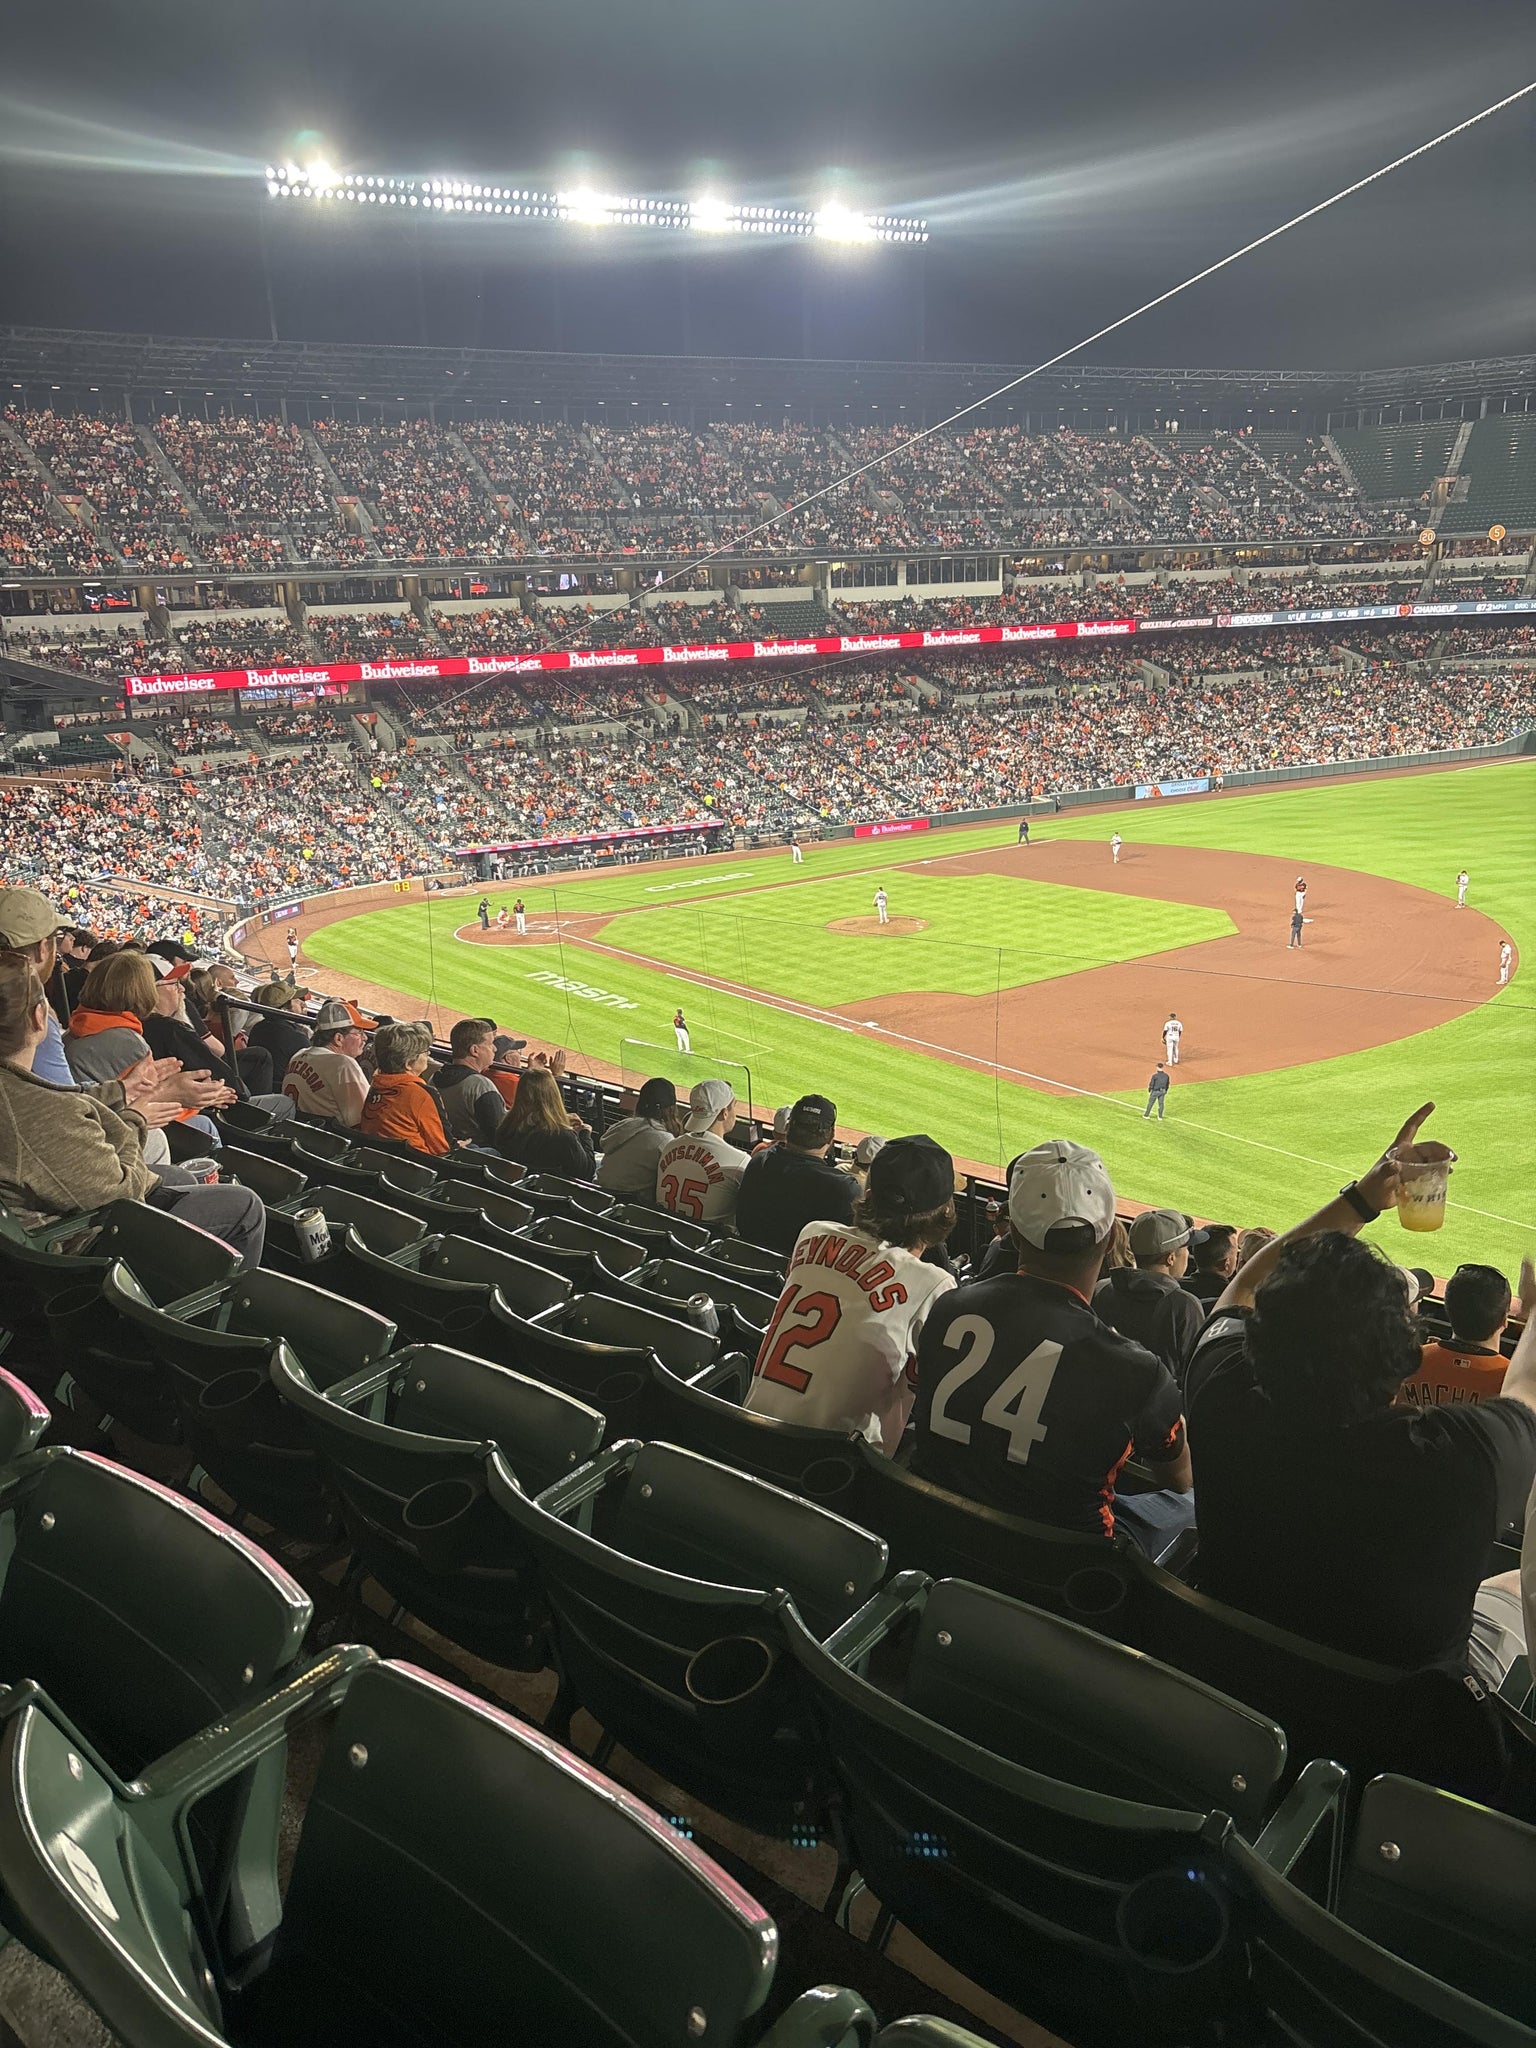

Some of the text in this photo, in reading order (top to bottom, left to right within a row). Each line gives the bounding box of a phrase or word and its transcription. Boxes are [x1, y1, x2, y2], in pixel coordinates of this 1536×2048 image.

[1422, 532, 1433, 541] 20
[1494, 528, 1500, 537] 5
[1231, 614, 1273, 625] HENDERSON
[1413, 605, 1458, 614] CHANGEUP
[882, 824, 912, 833] Budweiser
[660, 1144, 725, 1185] RUTSCHMAN
[661, 1174, 709, 1221] 35
[787, 1234, 908, 1313] EYNOLDS
[754, 1284, 842, 1394] 12
[930, 1313, 1064, 1465] 24
